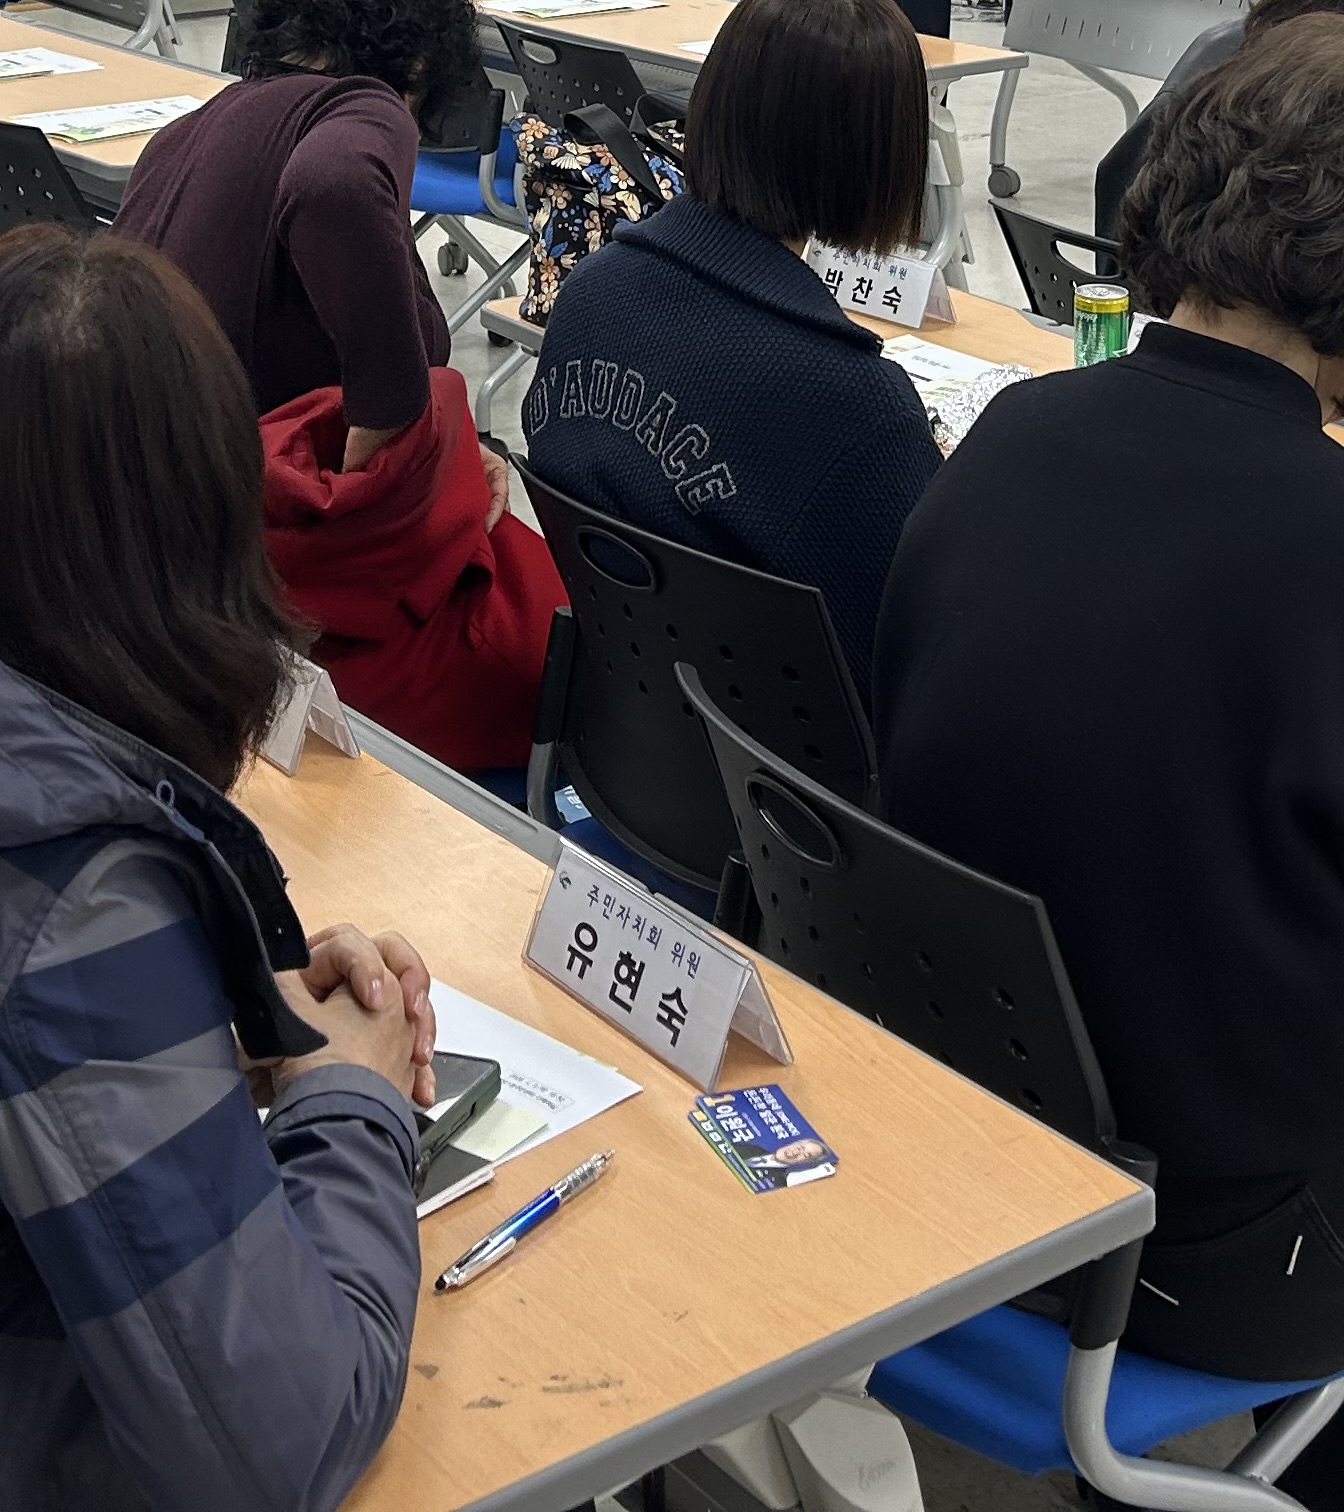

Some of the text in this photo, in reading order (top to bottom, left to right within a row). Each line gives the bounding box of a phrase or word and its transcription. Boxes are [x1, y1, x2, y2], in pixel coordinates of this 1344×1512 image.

[824, 268, 902, 314] 박찬숙
[888, 264, 908, 280] 위원
[529, 359, 737, 516] D'AUDACE
[587, 884, 701, 979] 주민자치회 위원
[566, 921, 688, 1048] 유현숙
